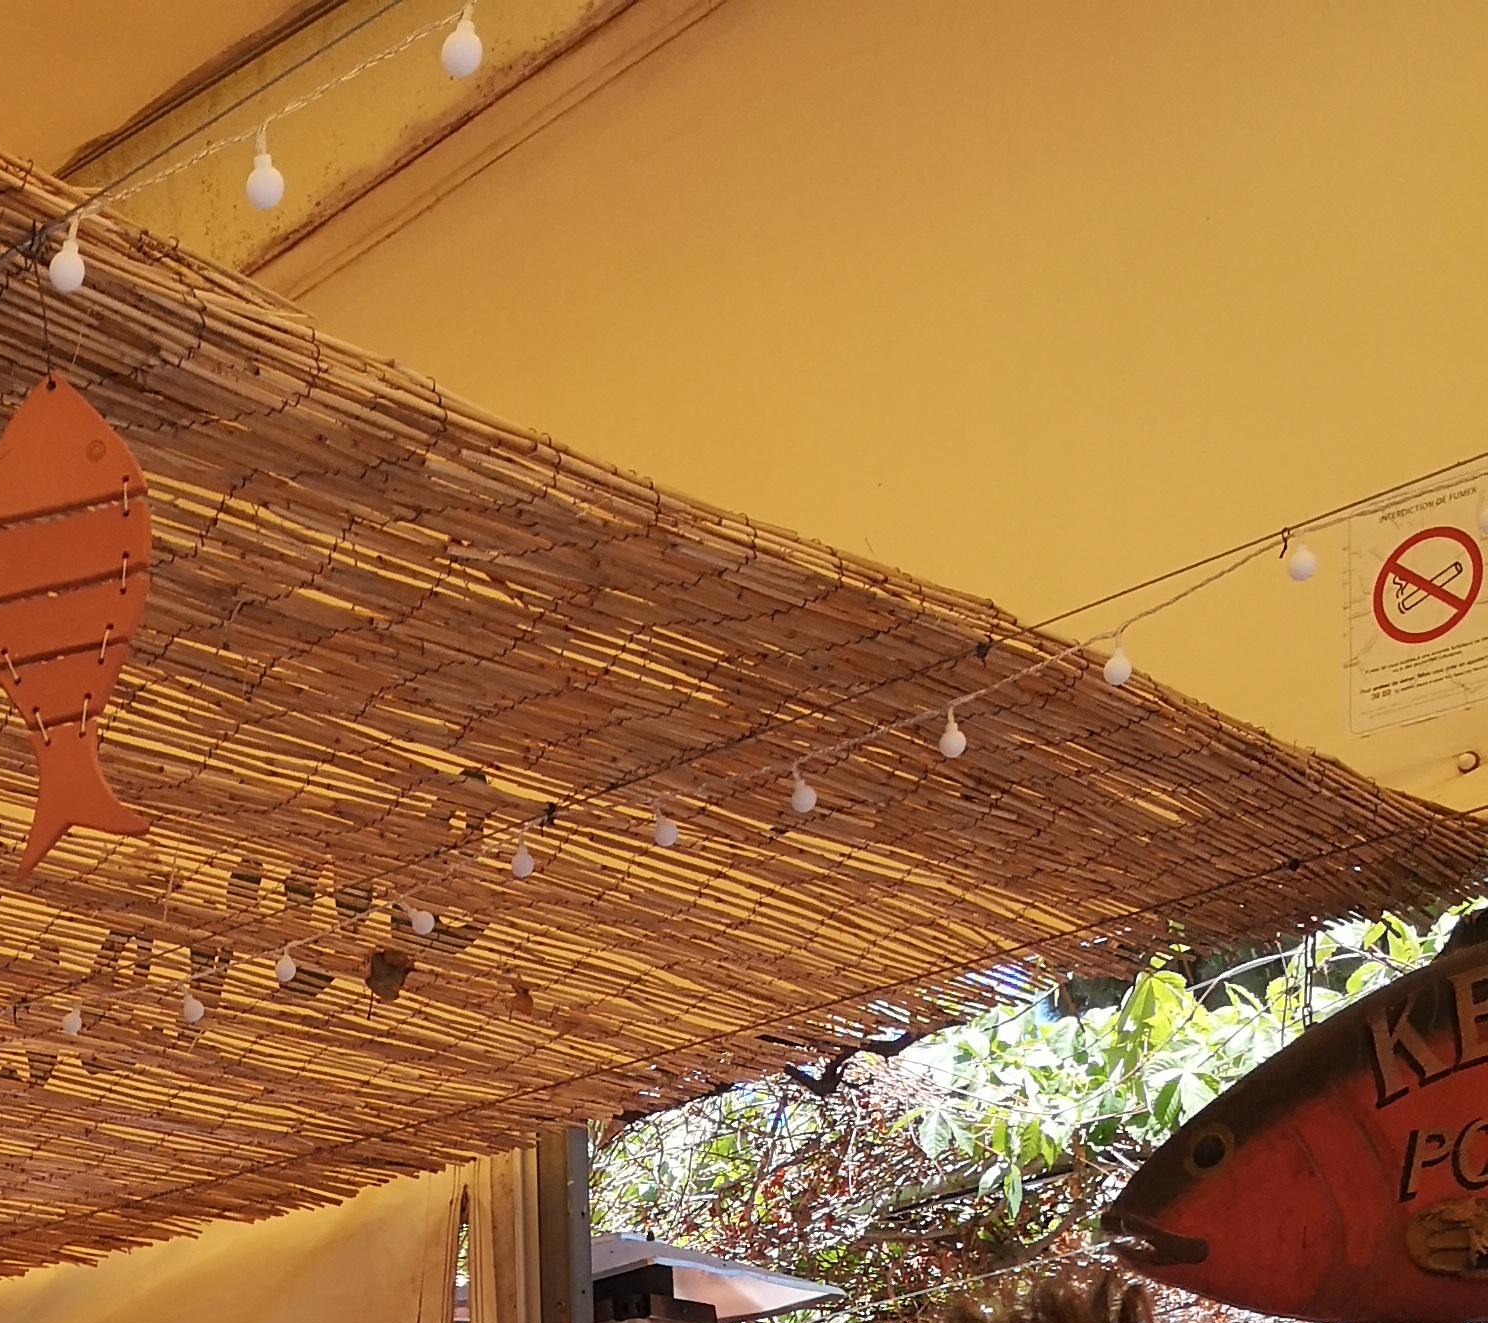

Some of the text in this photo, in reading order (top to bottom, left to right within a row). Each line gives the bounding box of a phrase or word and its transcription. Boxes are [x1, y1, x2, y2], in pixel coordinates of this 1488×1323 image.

[1379, 486, 1478, 523] INTERDICTION DE FUMER
